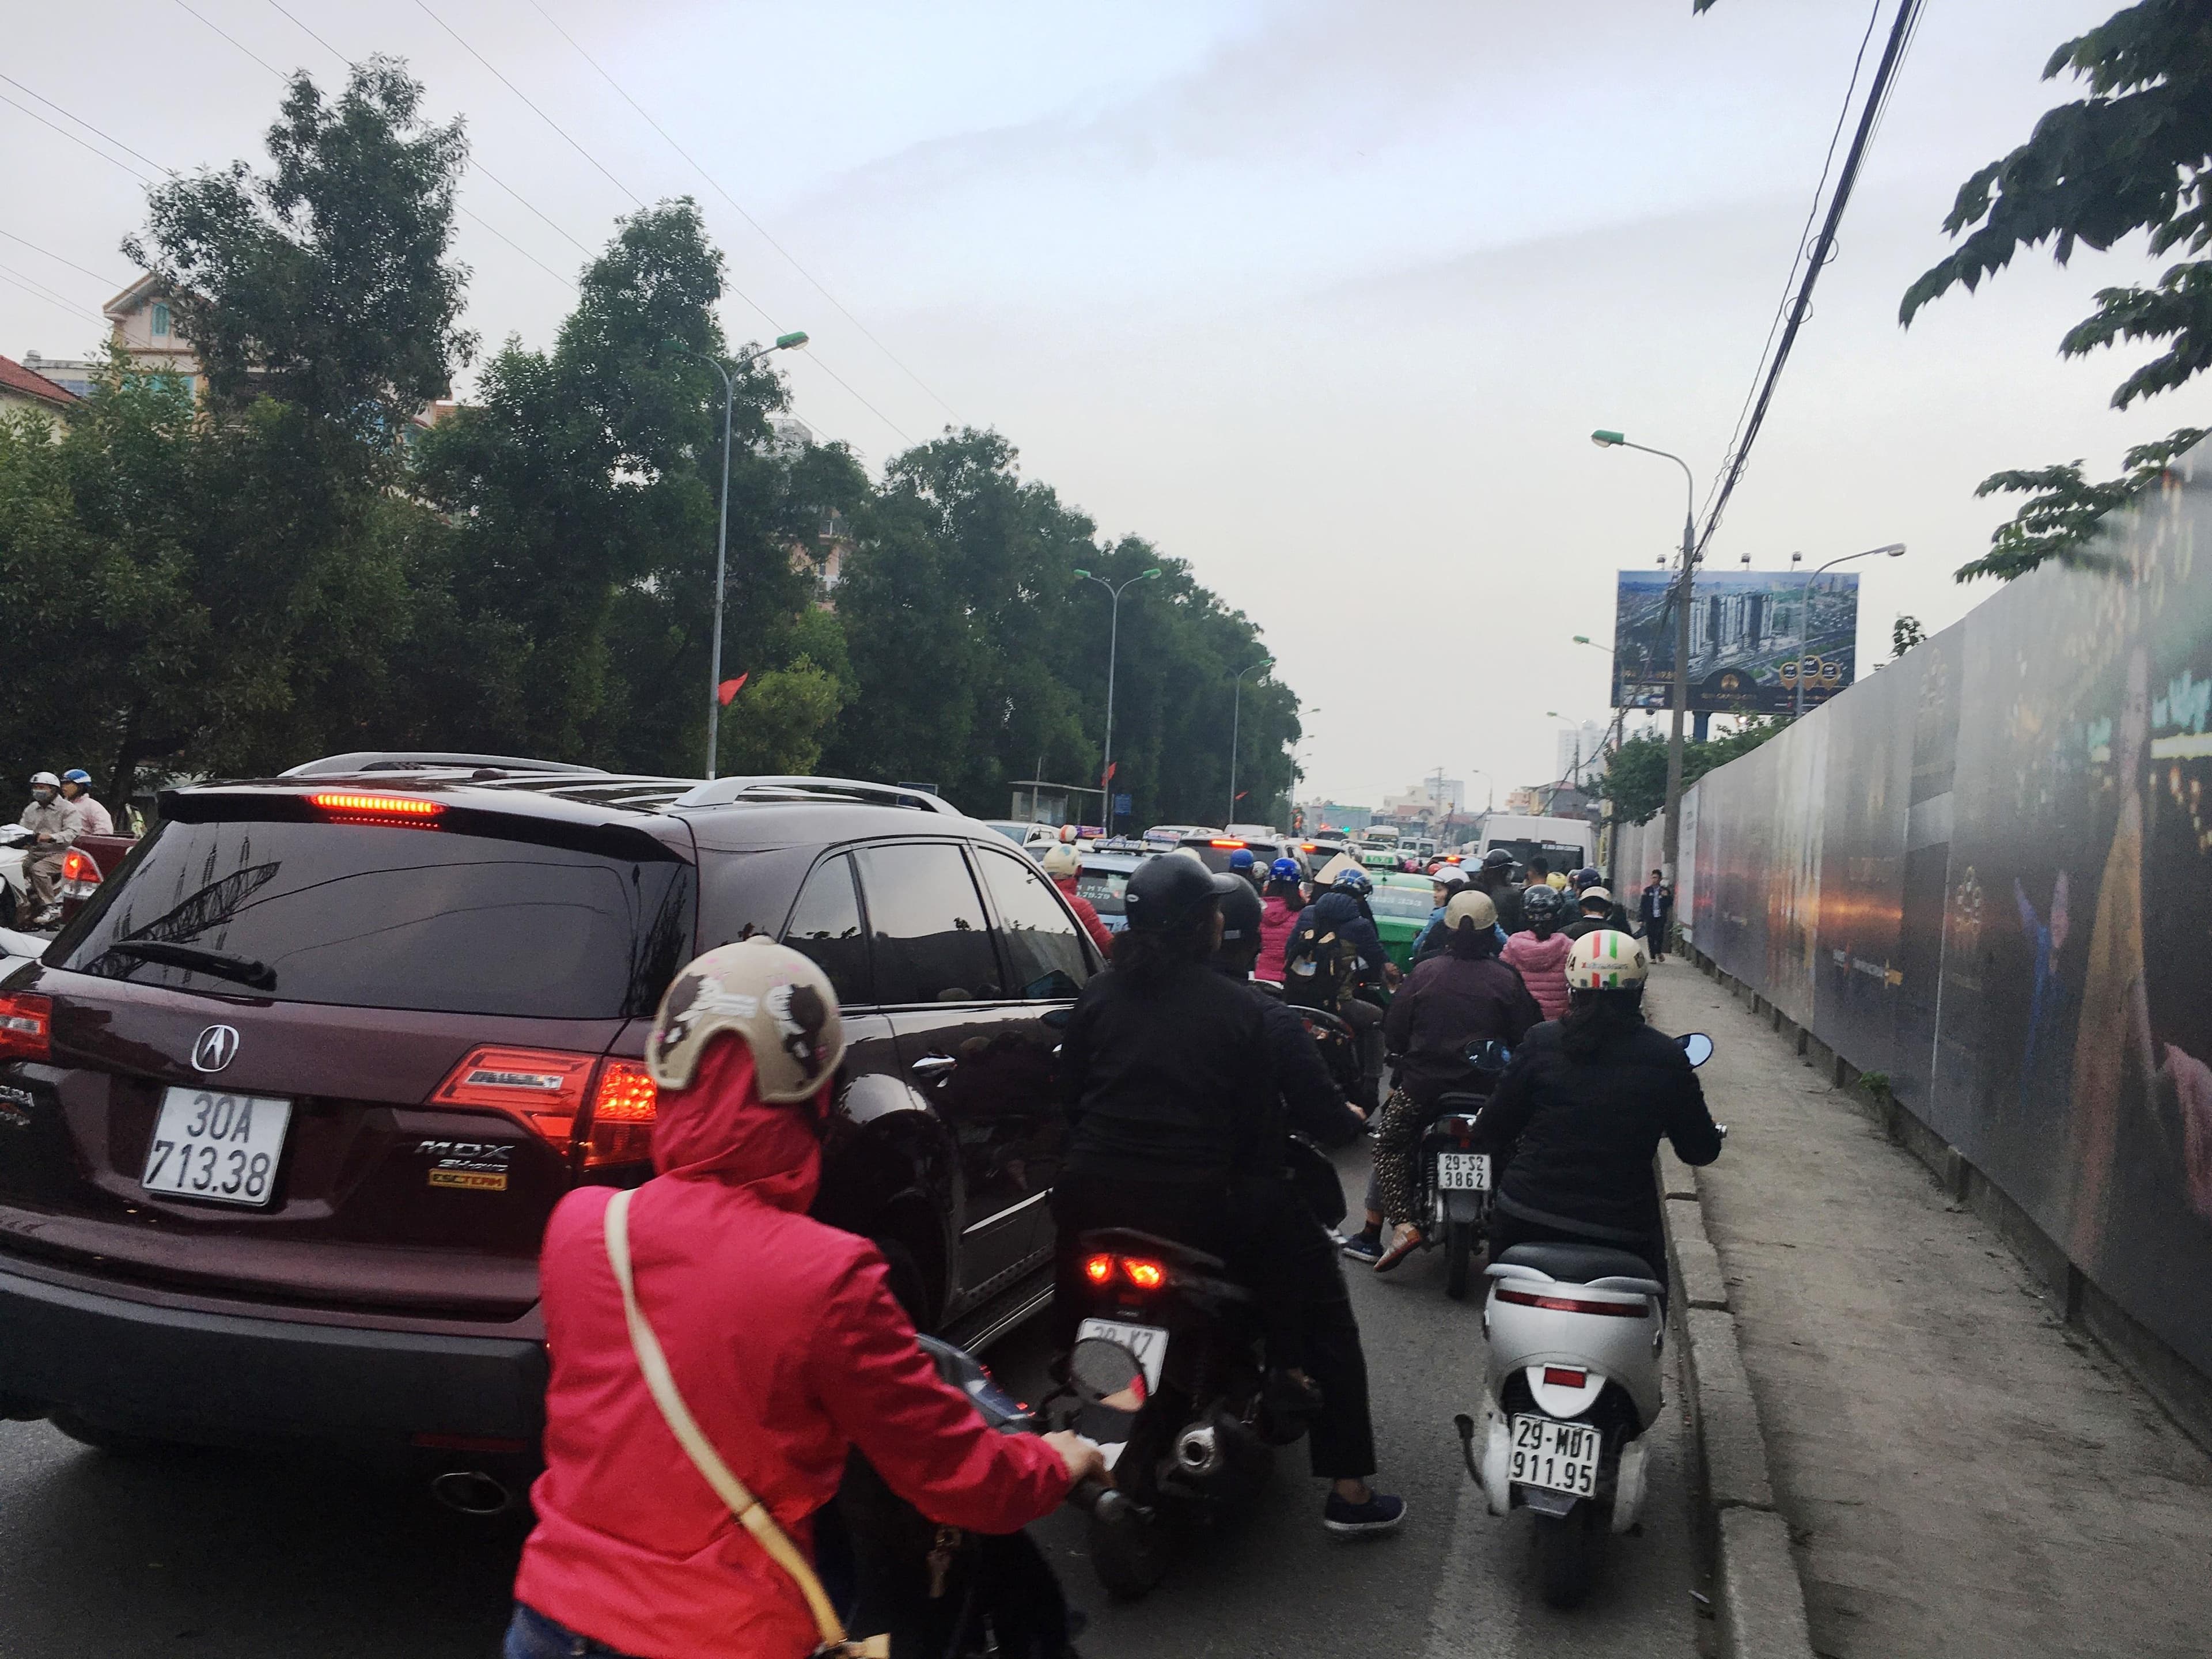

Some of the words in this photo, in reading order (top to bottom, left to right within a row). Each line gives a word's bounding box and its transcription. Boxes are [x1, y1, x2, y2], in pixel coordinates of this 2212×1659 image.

[187, 1093, 253, 1143] 30A
[414, 1141, 516, 1159] MDX
[1445, 1155, 1484, 1171] 29-S2
[146, 1140, 270, 1196] 713.38
[1445, 1172, 1484, 1188] 3862
[1512, 1451, 1593, 1493] 911.95
